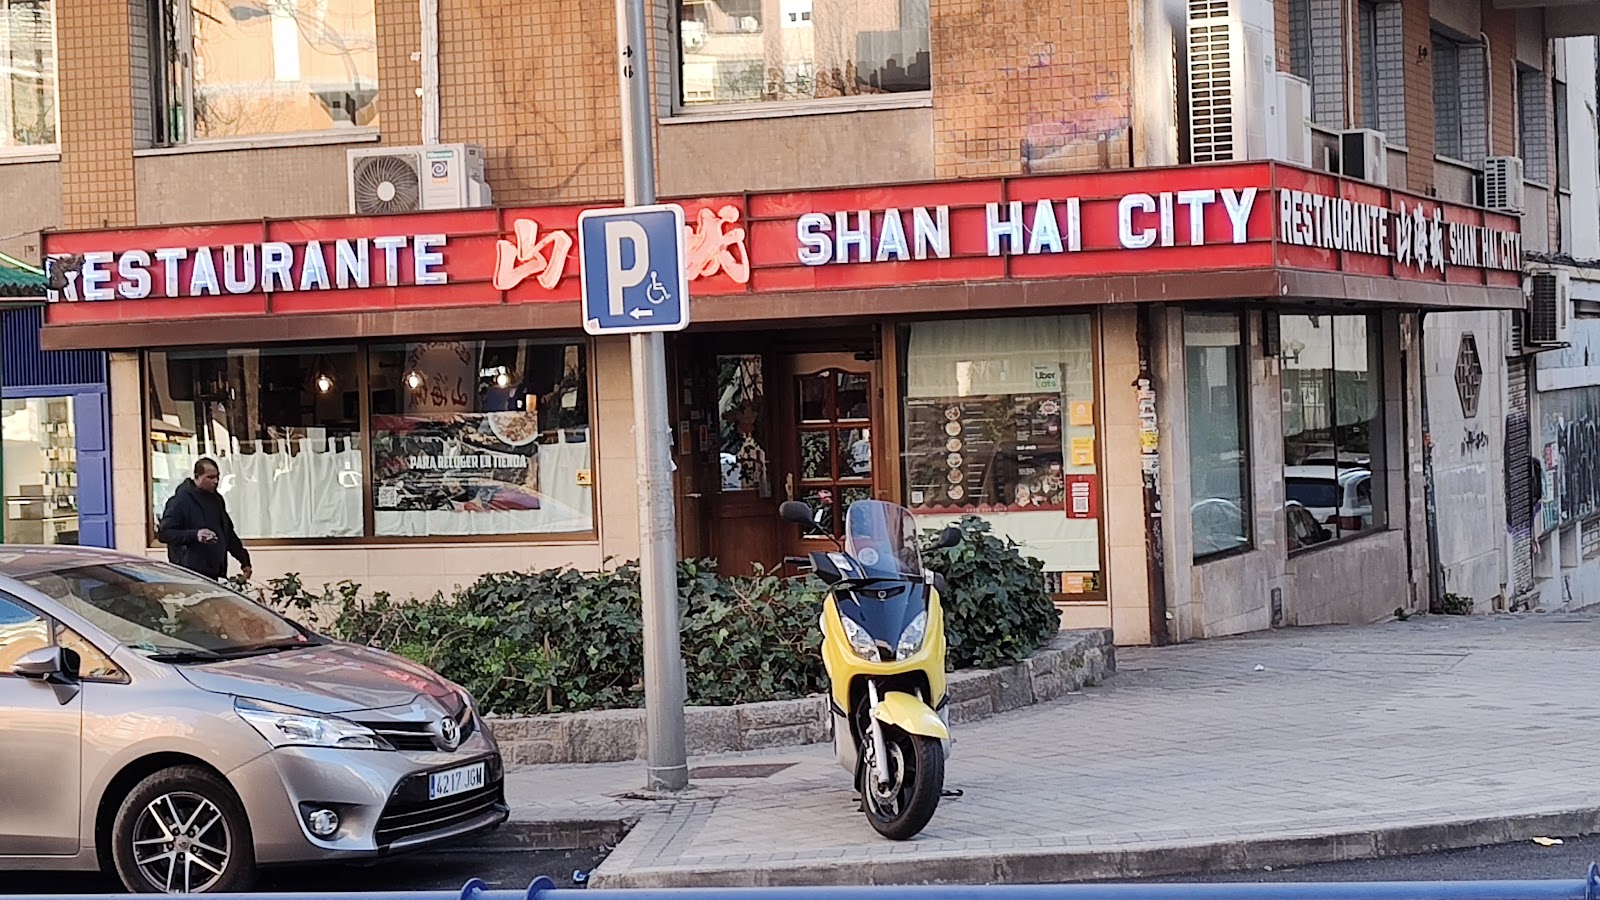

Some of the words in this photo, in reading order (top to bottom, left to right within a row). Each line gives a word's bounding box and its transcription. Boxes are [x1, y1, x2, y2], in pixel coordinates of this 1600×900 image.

[797, 205, 951, 266] SHAN
[985, 197, 1081, 255] HAI
[1117, 187, 1258, 249] CITY
[1280, 188, 1389, 256] RESTAURANTE
[1450, 222, 1478, 267] SHAN
[1481, 227, 1499, 270] HAI
[1501, 230, 1522, 272] CITY
[604, 220, 650, 316] P
[1035, 371, 1056, 380] Uber
[410, 455, 436, 469] PARA
[437, 455, 479, 469] RECOGER
[493, 454, 527, 468] TIENDA
[436, 771, 462, 794] 4217
